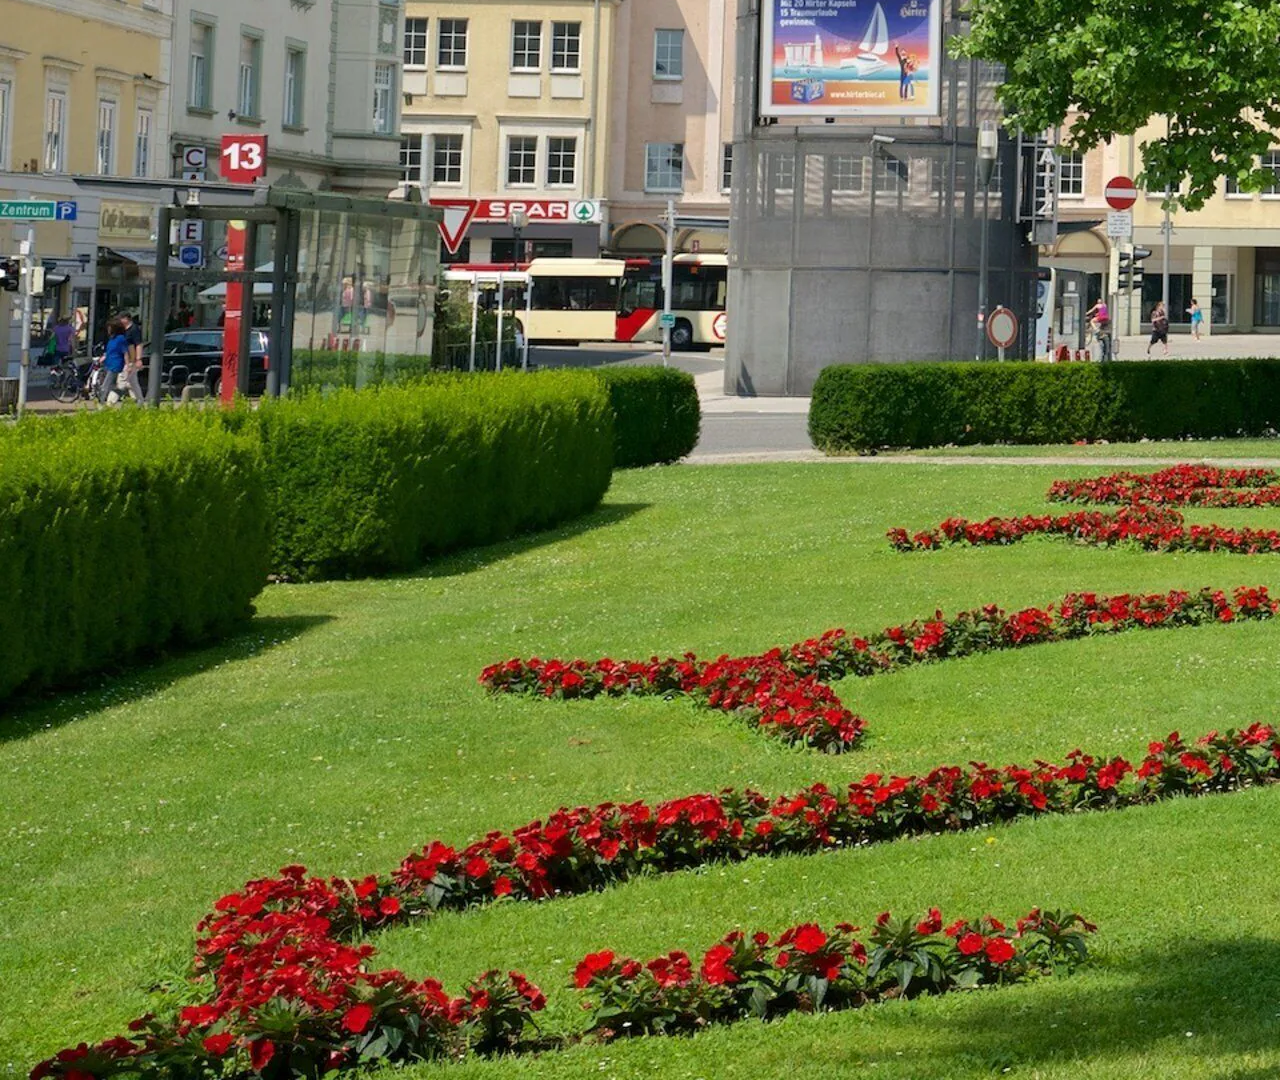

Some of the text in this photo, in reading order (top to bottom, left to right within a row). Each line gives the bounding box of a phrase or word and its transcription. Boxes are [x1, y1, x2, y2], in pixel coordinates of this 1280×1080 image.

[223, 142, 262, 170] 13
[1, 203, 51, 217] Zentrum
[488, 201, 568, 218] SPAR
